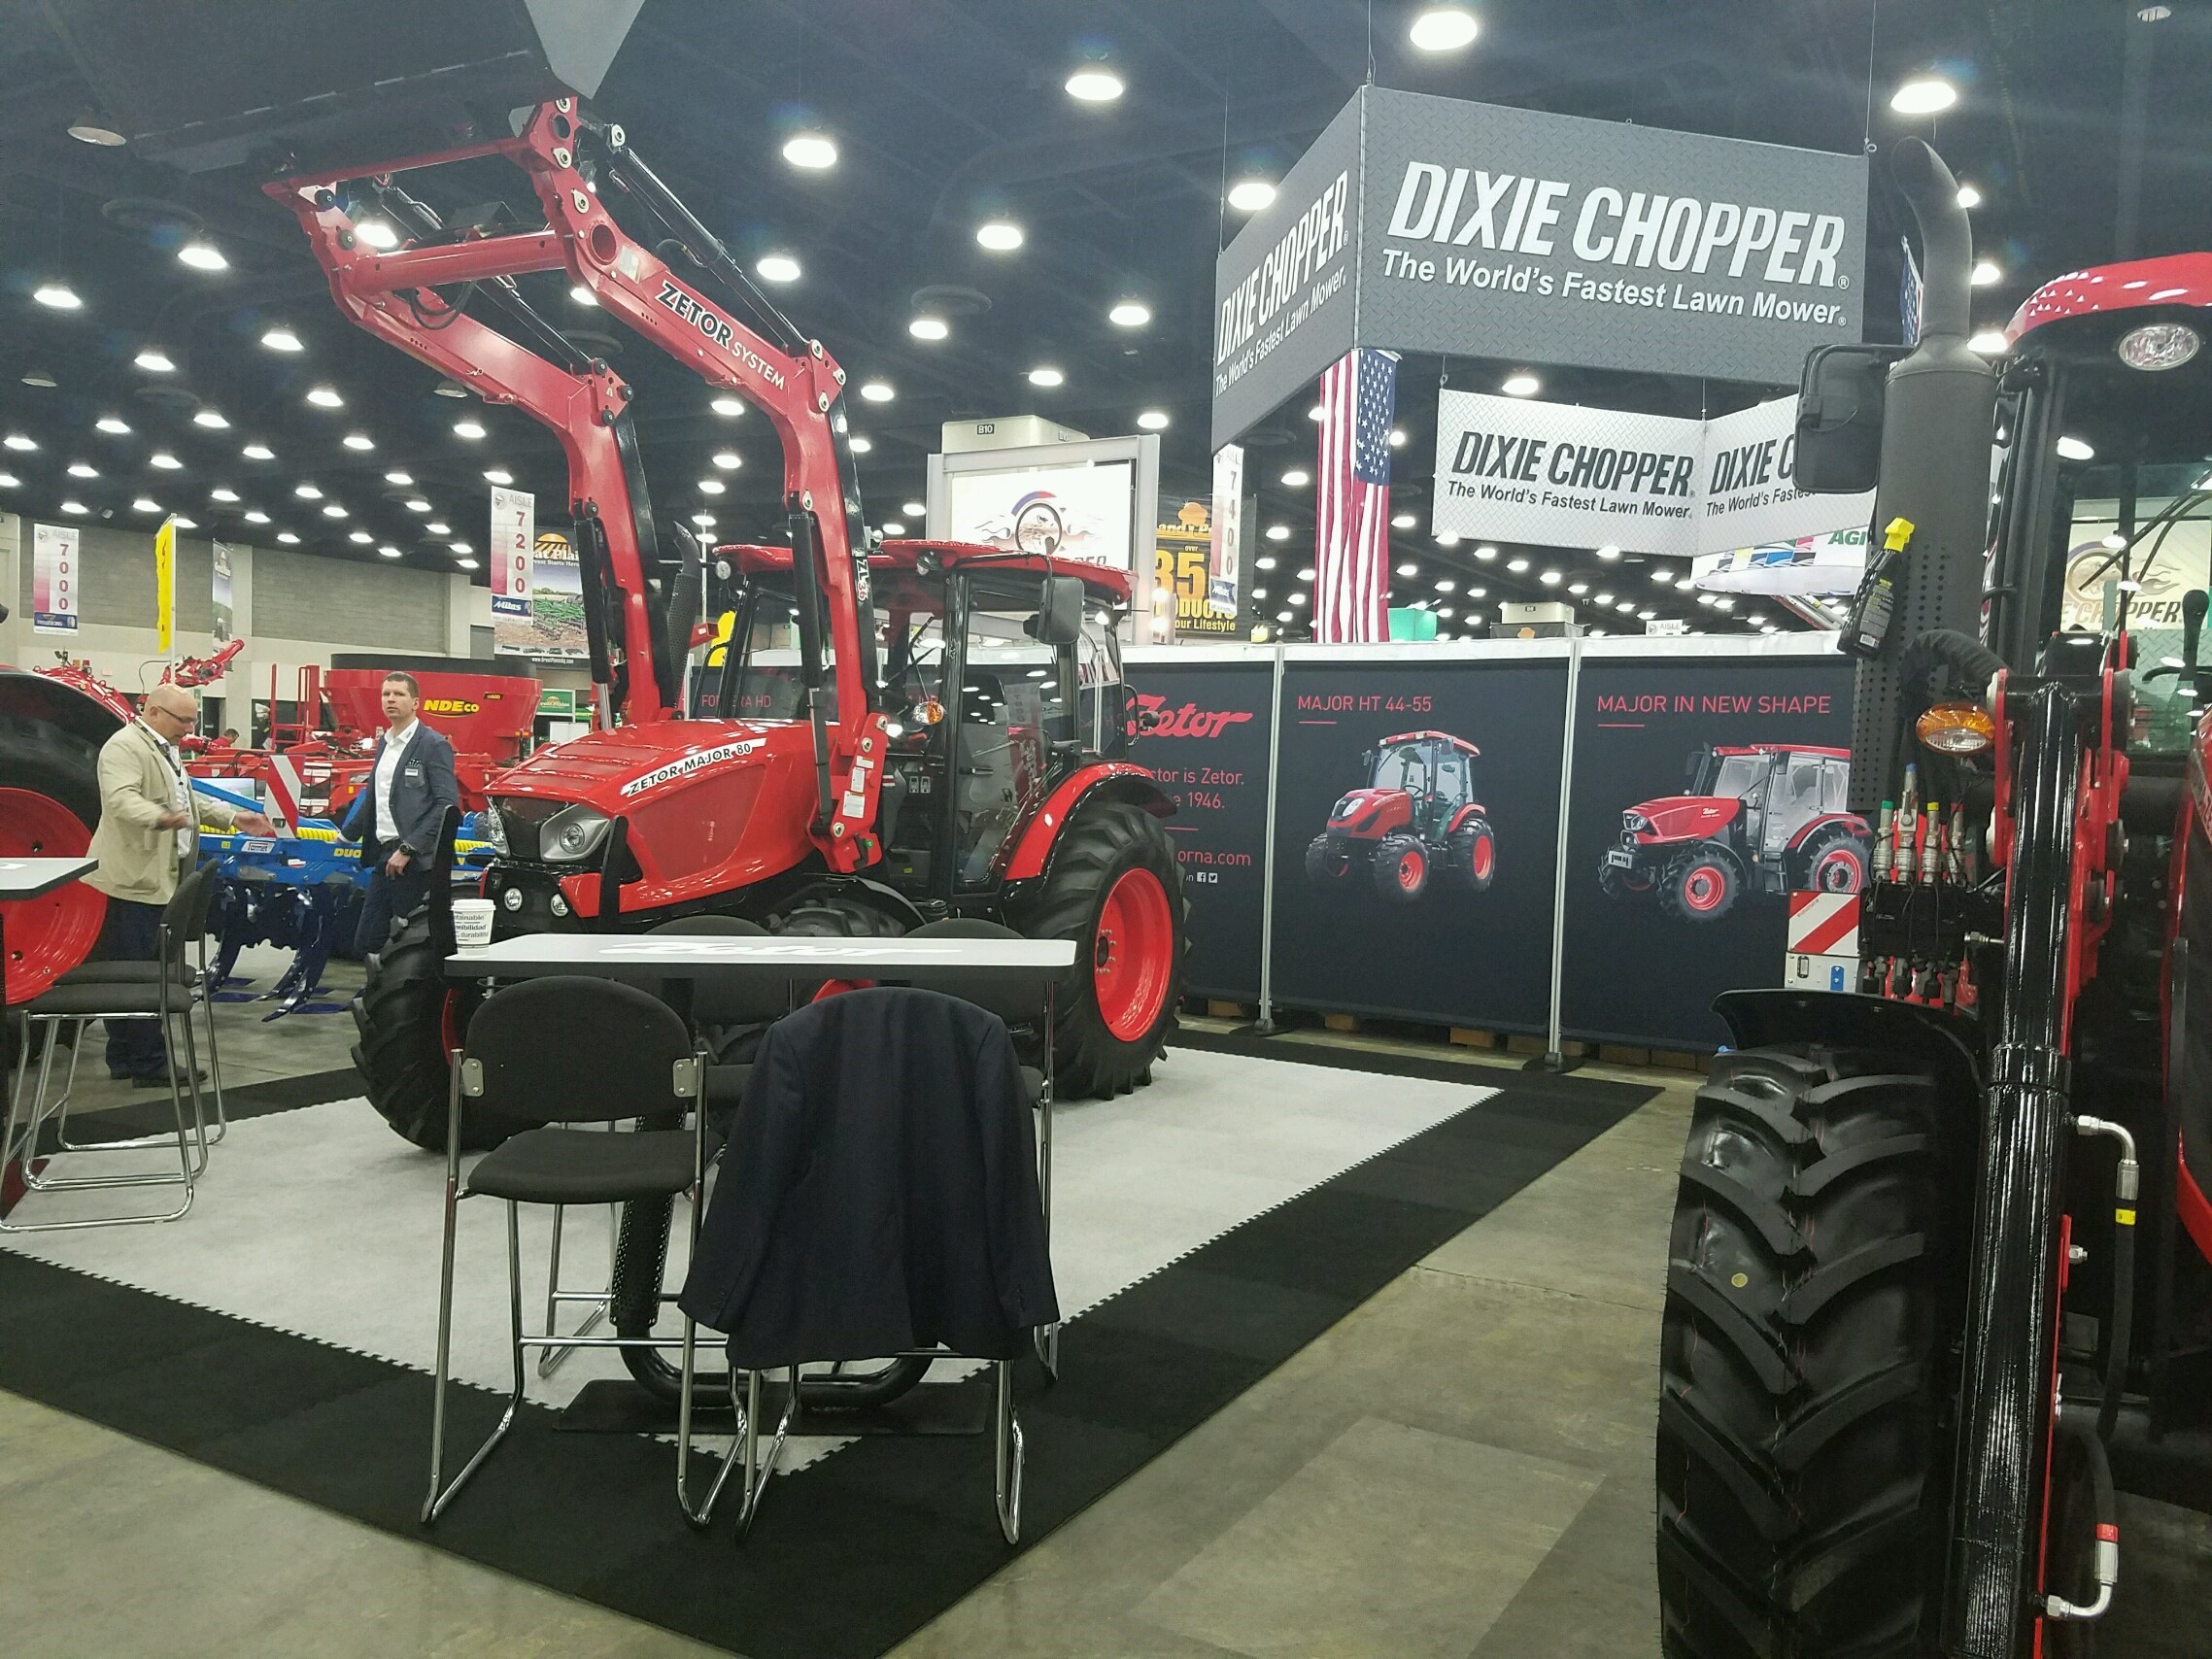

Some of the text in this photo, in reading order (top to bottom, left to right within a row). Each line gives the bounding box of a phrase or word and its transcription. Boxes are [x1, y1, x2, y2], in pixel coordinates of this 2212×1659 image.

[1387, 161, 1571, 255] DIXIE
[1382, 249, 1436, 282] The
[1562, 272, 1666, 308] Fastest
[1672, 284, 1744, 315] Lawn
[655, 280, 785, 390] ZETOR SYSTEM
[1217, 266, 1260, 366] DIXIE
[1215, 371, 1228, 397] The
[1254, 327, 1285, 365] Fastest
[1284, 299, 1309, 332] Lawn
[1451, 431, 1547, 482] DIXIE
[1709, 439, 1778, 495] DIXIE
[509, 494, 532, 507] AISLE
[1447, 481, 1475, 497] The
[1542, 491, 1595, 511] Fastest
[1600, 497, 1638, 515] Lawn
[1706, 501, 1724, 517] The
[515, 511, 526, 593] 7200
[553, 549, 579, 560] Plai
[58, 543, 69, 610] 7000
[1155, 549, 1210, 600] 35
[1174, 618, 1236, 633] our Lifestyle
[756, 694, 771, 708] HD
[1126, 694, 1253, 738] Zetor
[1298, 695, 1432, 713] MAJOR HT 44-55
[1597, 695, 1831, 714] MAJOR IN NEW SHAPE
[630, 743, 751, 795] ZETOR MAJOR 80
[1183, 767, 1196, 784] is
[1201, 767, 1244, 785] Zetor.
[1187, 792, 1225, 808] 1946.
[1177, 850, 1251, 866] orna.com
